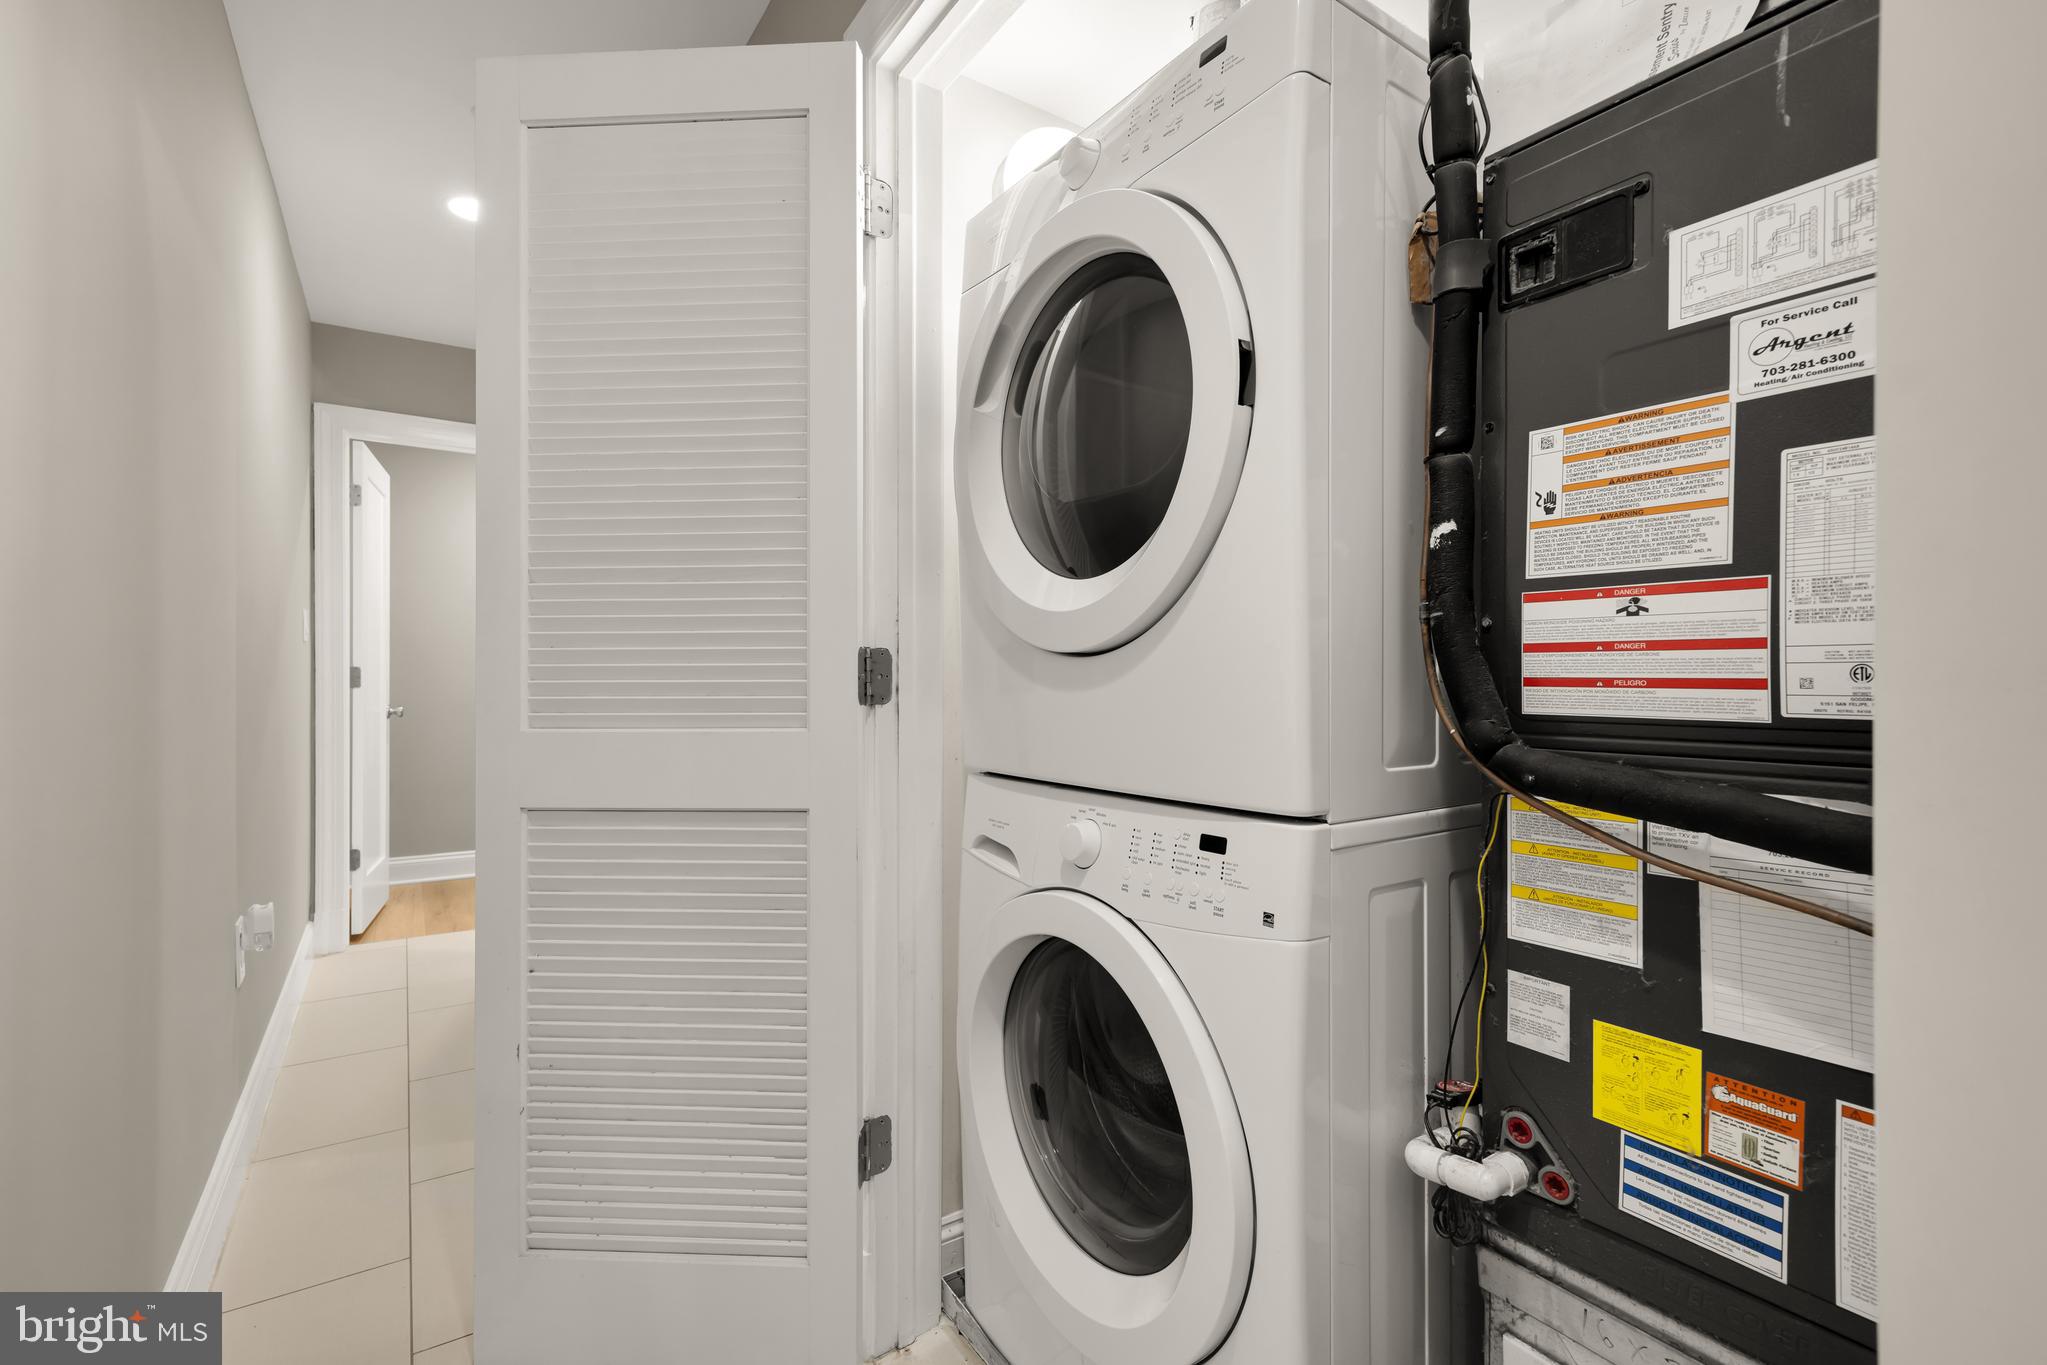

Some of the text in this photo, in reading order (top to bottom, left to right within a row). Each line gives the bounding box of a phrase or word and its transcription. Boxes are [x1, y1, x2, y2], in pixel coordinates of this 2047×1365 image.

[1657, 3, 1677, 41] Sentry
[1761, 297, 1858, 327] For Service Call
[1753, 322, 1855, 356] Argent
[1754, 361, 1864, 388] Heating/Air Conditioning
[1762, 351, 1856, 378] 703-281-6300
[1585, 428, 1609, 436] ELECTRIC
[1645, 417, 1663, 425] CAUSE
[1665, 412, 1686, 421] INJURY
[1625, 408, 1663, 422] WARNING
[1629, 426, 1671, 437] COMPARTMENT
[1699, 415, 1724, 424] CLOSED
[1565, 435, 1596, 445] DISCONNECT
[1609, 428, 1631, 436] REMOTE
[1632, 423, 1658, 432] ELECTRIC
[1660, 418, 1681, 426] POWER
[1683, 412, 1711, 422] SUPPLIES
[1613, 436, 1680, 454] AVERTISSEMENT
[1684, 440, 1709, 448] COUPEZ
[1566, 468, 1604, 478] COMPARTIMENT
[1679, 451, 1706, 459] PENDANT
[1573, 464, 1596, 472] COURANT
[1615, 469, 1673, 483] ADVERTENCIA
[1682, 470, 1722, 480] DESCONECTE
[1684, 477, 1704, 485] ANTES
[1565, 497, 1605, 507] MANTENIMIENTO
[1672, 480, 1724, 492] COMPARTIMENTO
[1579, 501, 1614, 509] PERMANECER
[1615, 497, 1641, 505] CERRADO
[1643, 493, 1669, 501] EXCEPTO
[1606, 509, 1643, 519] WARNING
[1614, 588, 1646, 596] DANGER
[1713, 1076, 1797, 1106] ATTENTION
[1729, 1092, 1796, 1123] AquaGuard
[1641, 1142, 1762, 1195] INSTALLAON NOTICE
